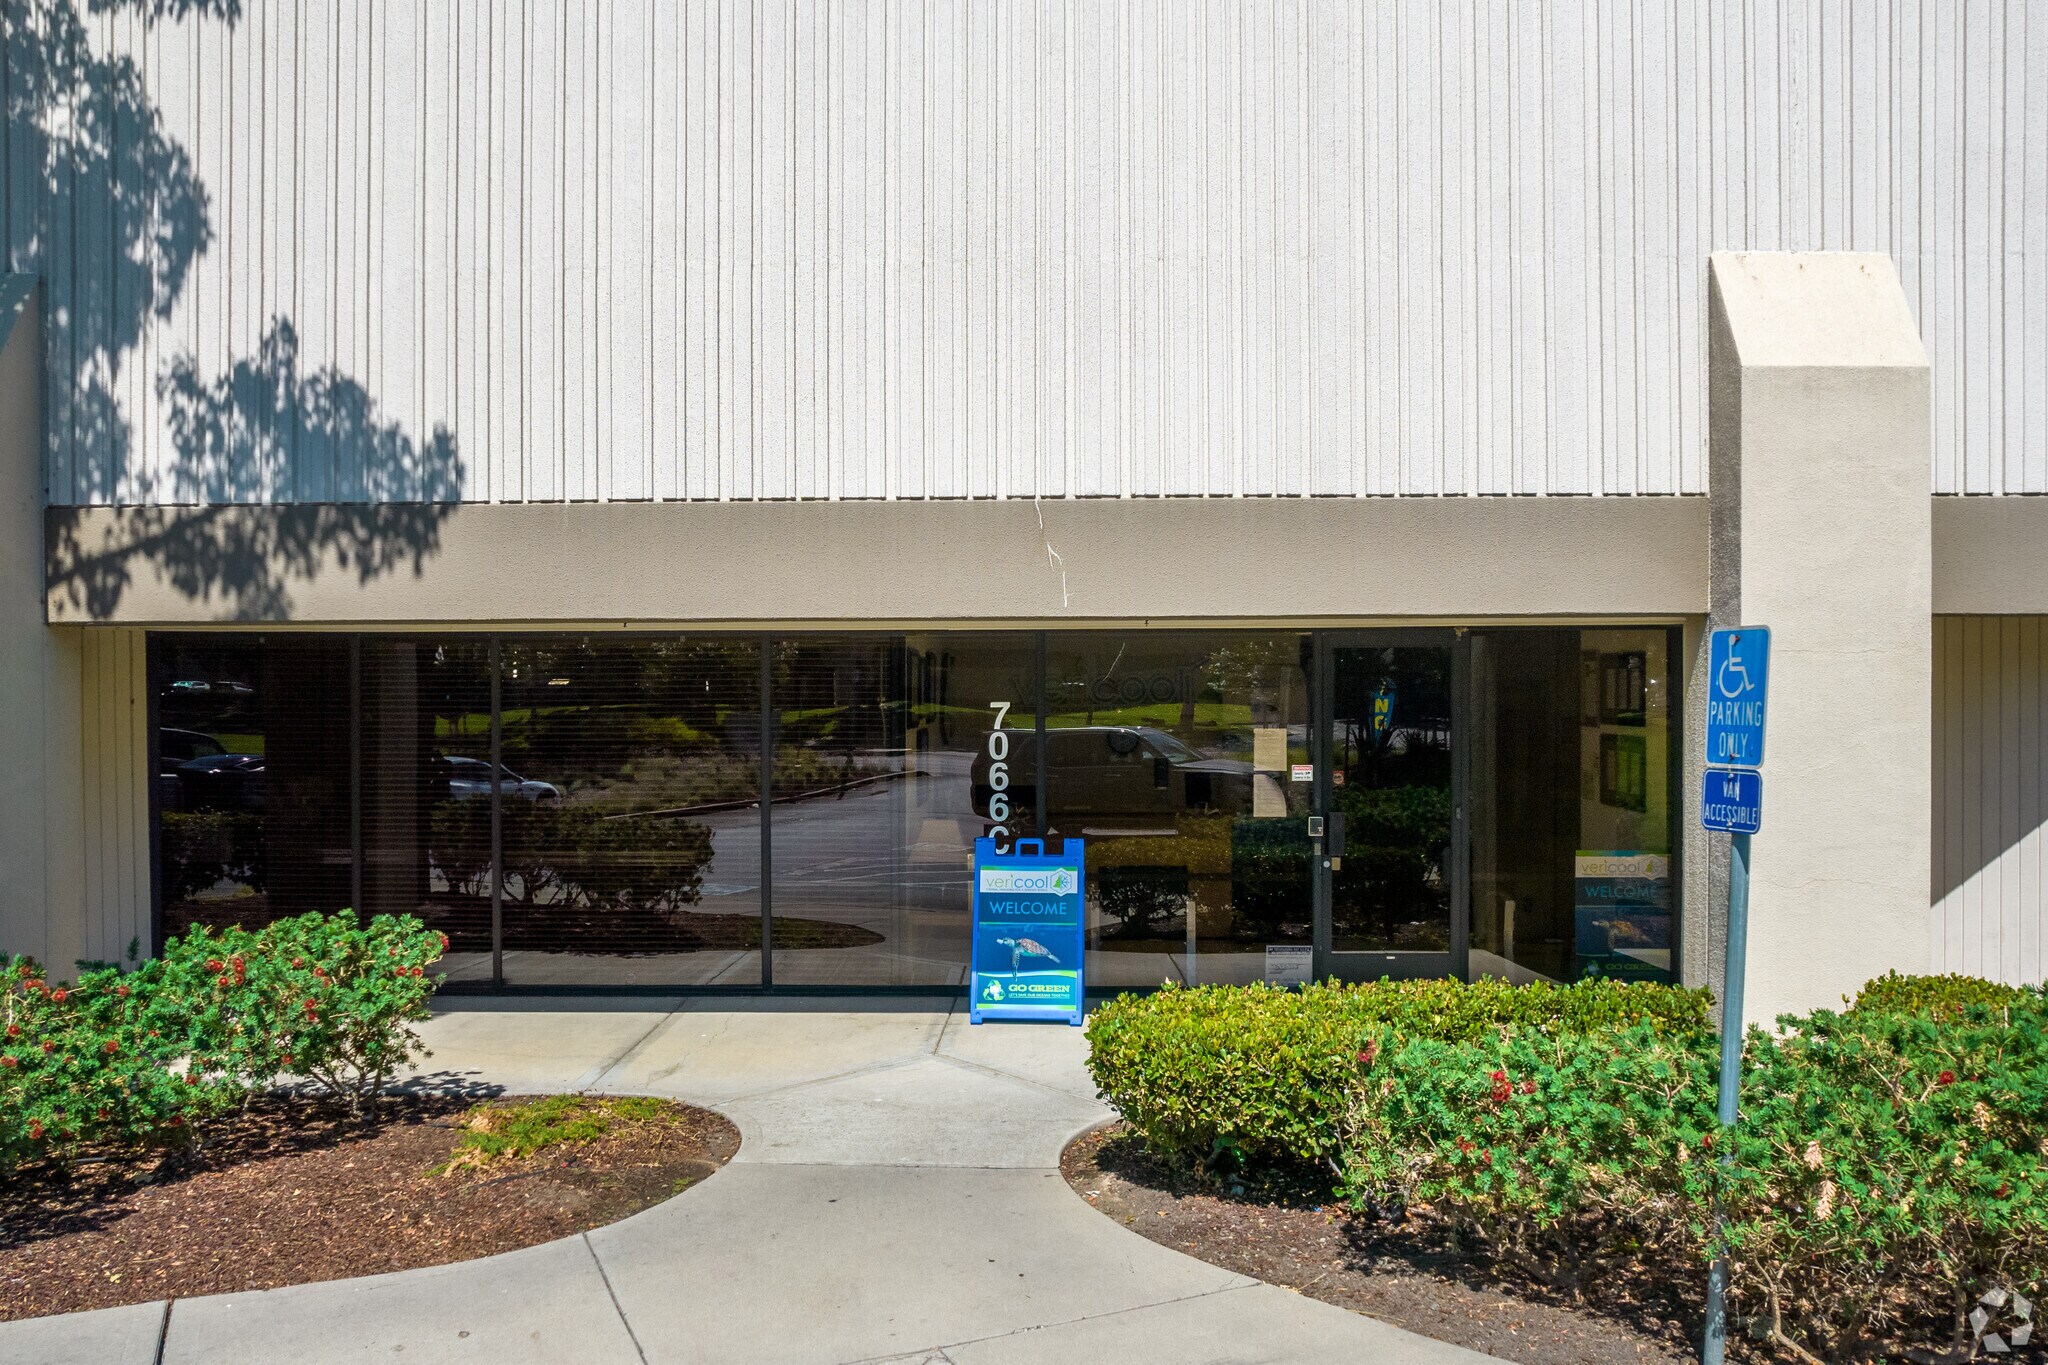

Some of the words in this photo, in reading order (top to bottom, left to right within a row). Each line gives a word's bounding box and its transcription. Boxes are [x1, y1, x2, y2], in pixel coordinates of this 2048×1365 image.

[1710, 701, 1762, 727] PARKING
[1719, 732, 1749, 758] ONLY
[1723, 781, 1740, 799] VAN
[1704, 803, 1758, 826] ACCESSIBLE
[1581, 860, 1640, 873] vericool
[985, 874, 1048, 889] vericool
[1584, 885, 1658, 898] WELCOME
[990, 901, 1067, 915] WELCOME
[1008, 984, 1027, 992] GO
[1028, 984, 1070, 993] GREEN
